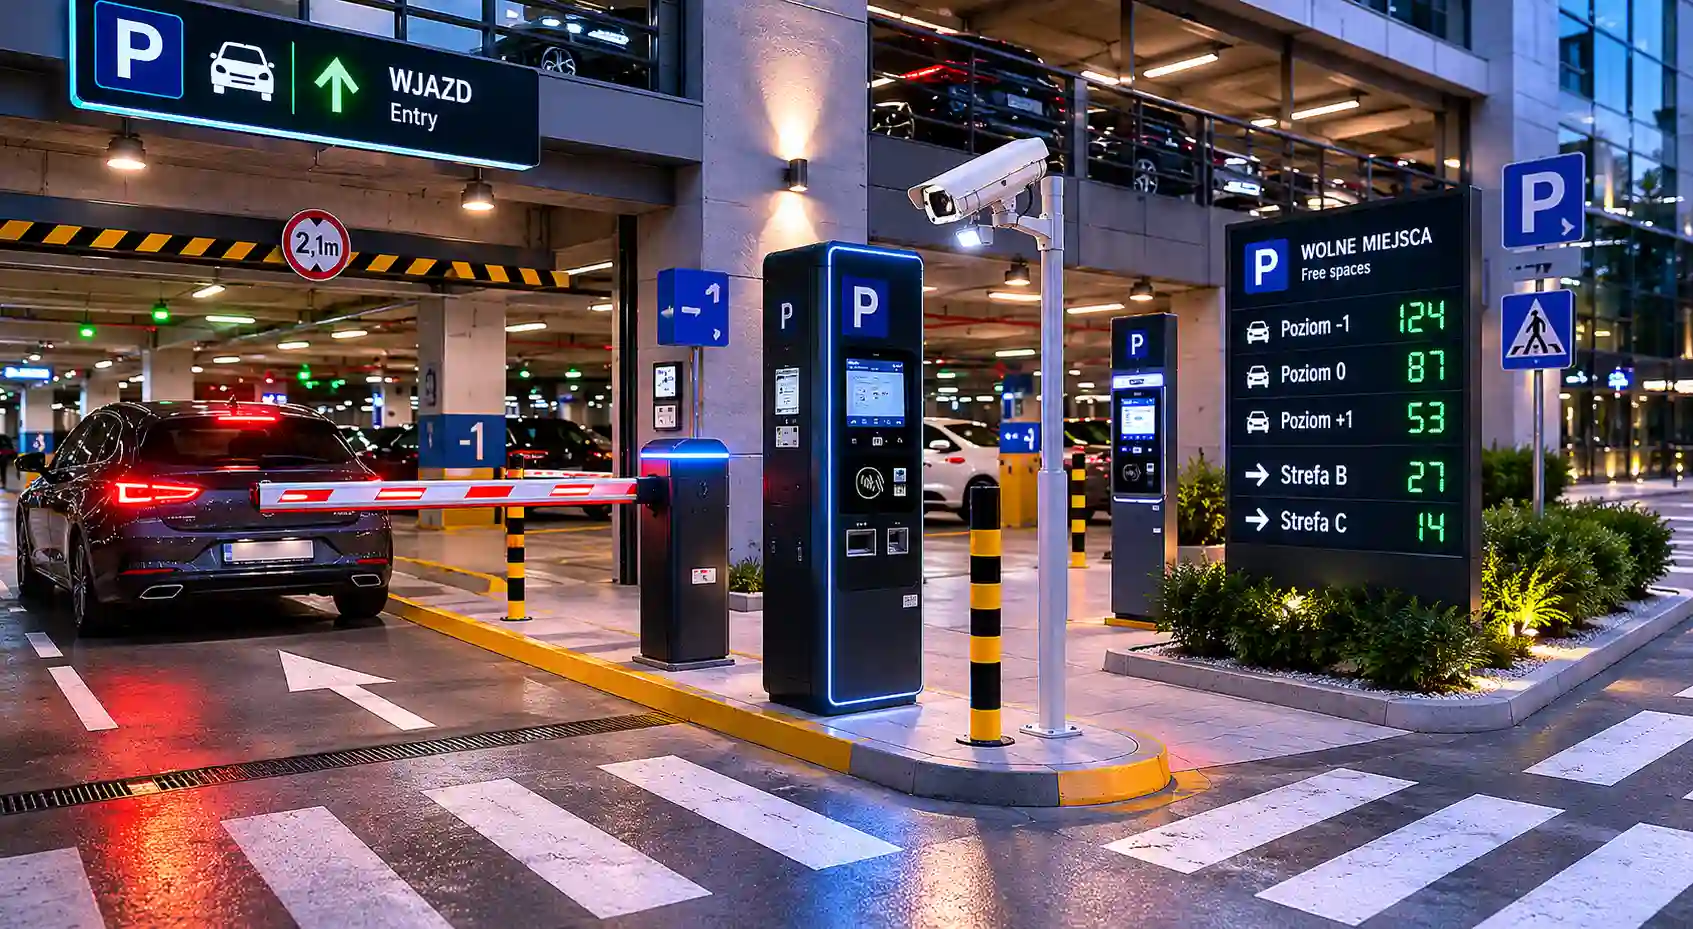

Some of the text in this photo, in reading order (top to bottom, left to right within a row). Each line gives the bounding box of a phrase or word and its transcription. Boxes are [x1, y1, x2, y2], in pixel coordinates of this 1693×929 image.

[116, 17, 163, 79] P
[388, 66, 473, 105] WJAZD
[390, 102, 438, 132] Entry
[1521, 171, 1566, 235] P
[295, 231, 340, 258] 2,1m
[1300, 226, 1433, 261] WOLNE MIEJSCA
[1255, 248, 1279, 286] P
[1301, 262, 1371, 282] Free spaces
[781, 302, 793, 330] P
[853, 285, 879, 328] P
[1399, 299, 1445, 334] 124
[1281, 314, 1350, 338] Poziom -1
[1131, 333, 1144, 355] P
[1281, 361, 1346, 383] Poziom 0
[1407, 349, 1445, 383] 87
[1281, 408, 1352, 430] Poziom +1
[1407, 401, 1445, 434] 53
[459, 421, 484, 461] -1
[1280, 464, 1348, 486] Strefa B
[1407, 461, 1445, 493] 27
[1280, 510, 1347, 533] Strefa C
[1418, 512, 1445, 543] 14
